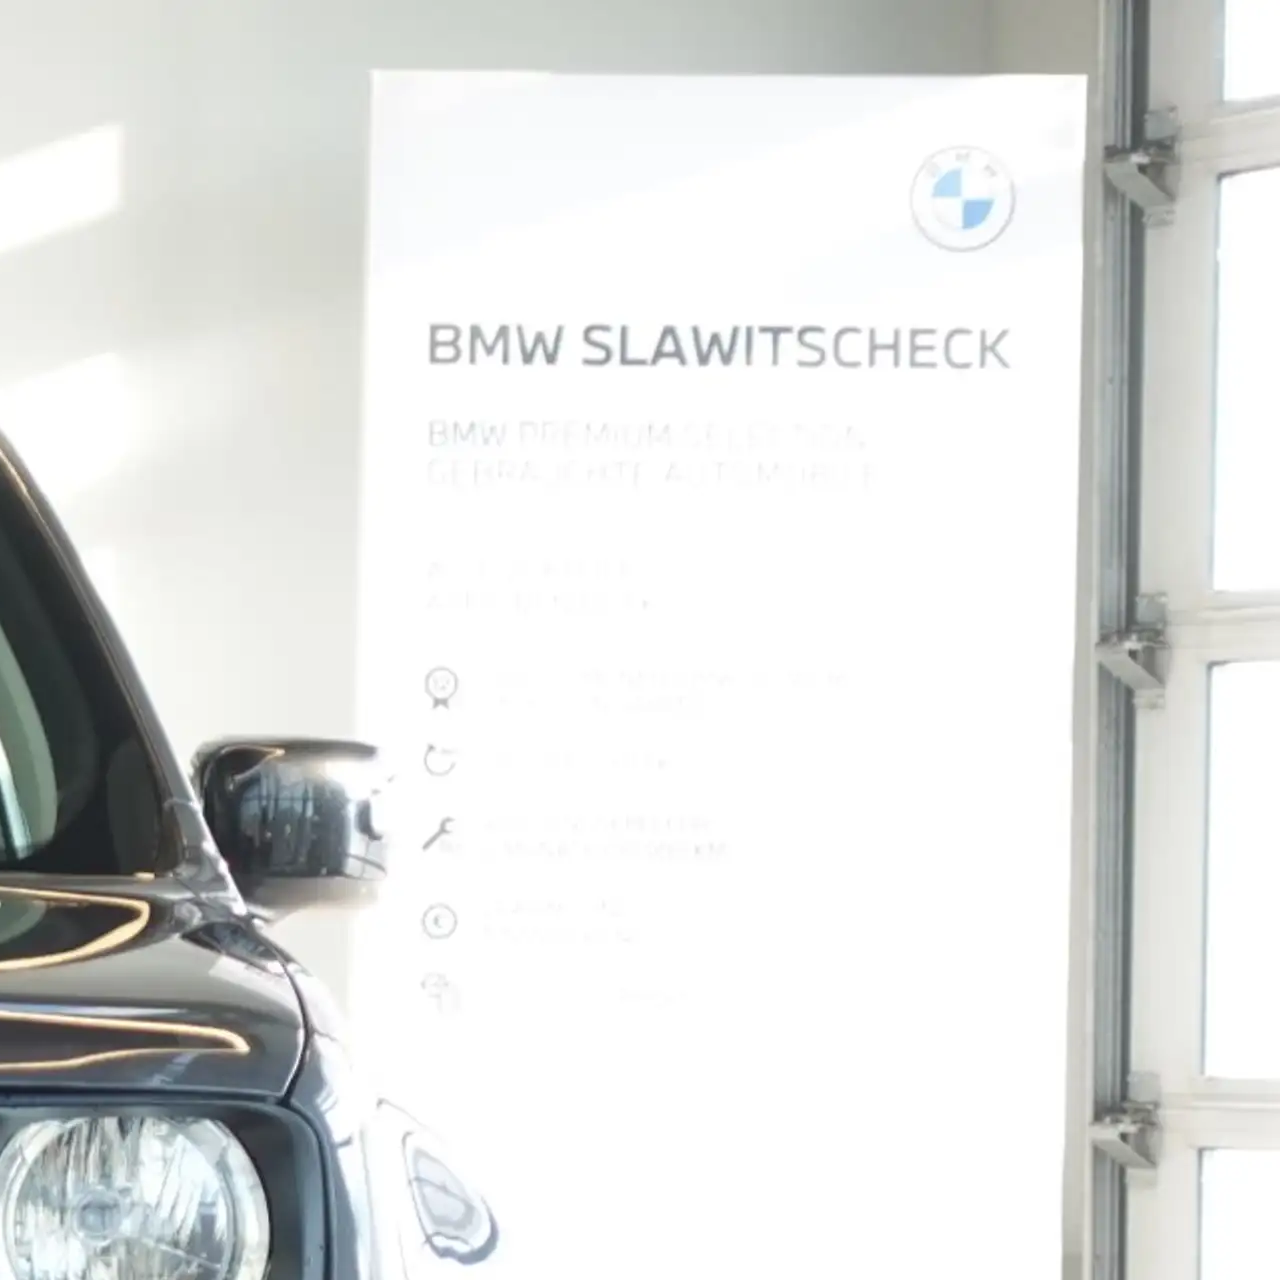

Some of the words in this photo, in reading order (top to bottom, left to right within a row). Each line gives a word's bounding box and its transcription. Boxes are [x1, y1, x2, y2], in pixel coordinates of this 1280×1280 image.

[428, 323, 564, 368] BMW
[581, 324, 1011, 369] SLAWITSCHECK
[426, 419, 508, 449] BMW
